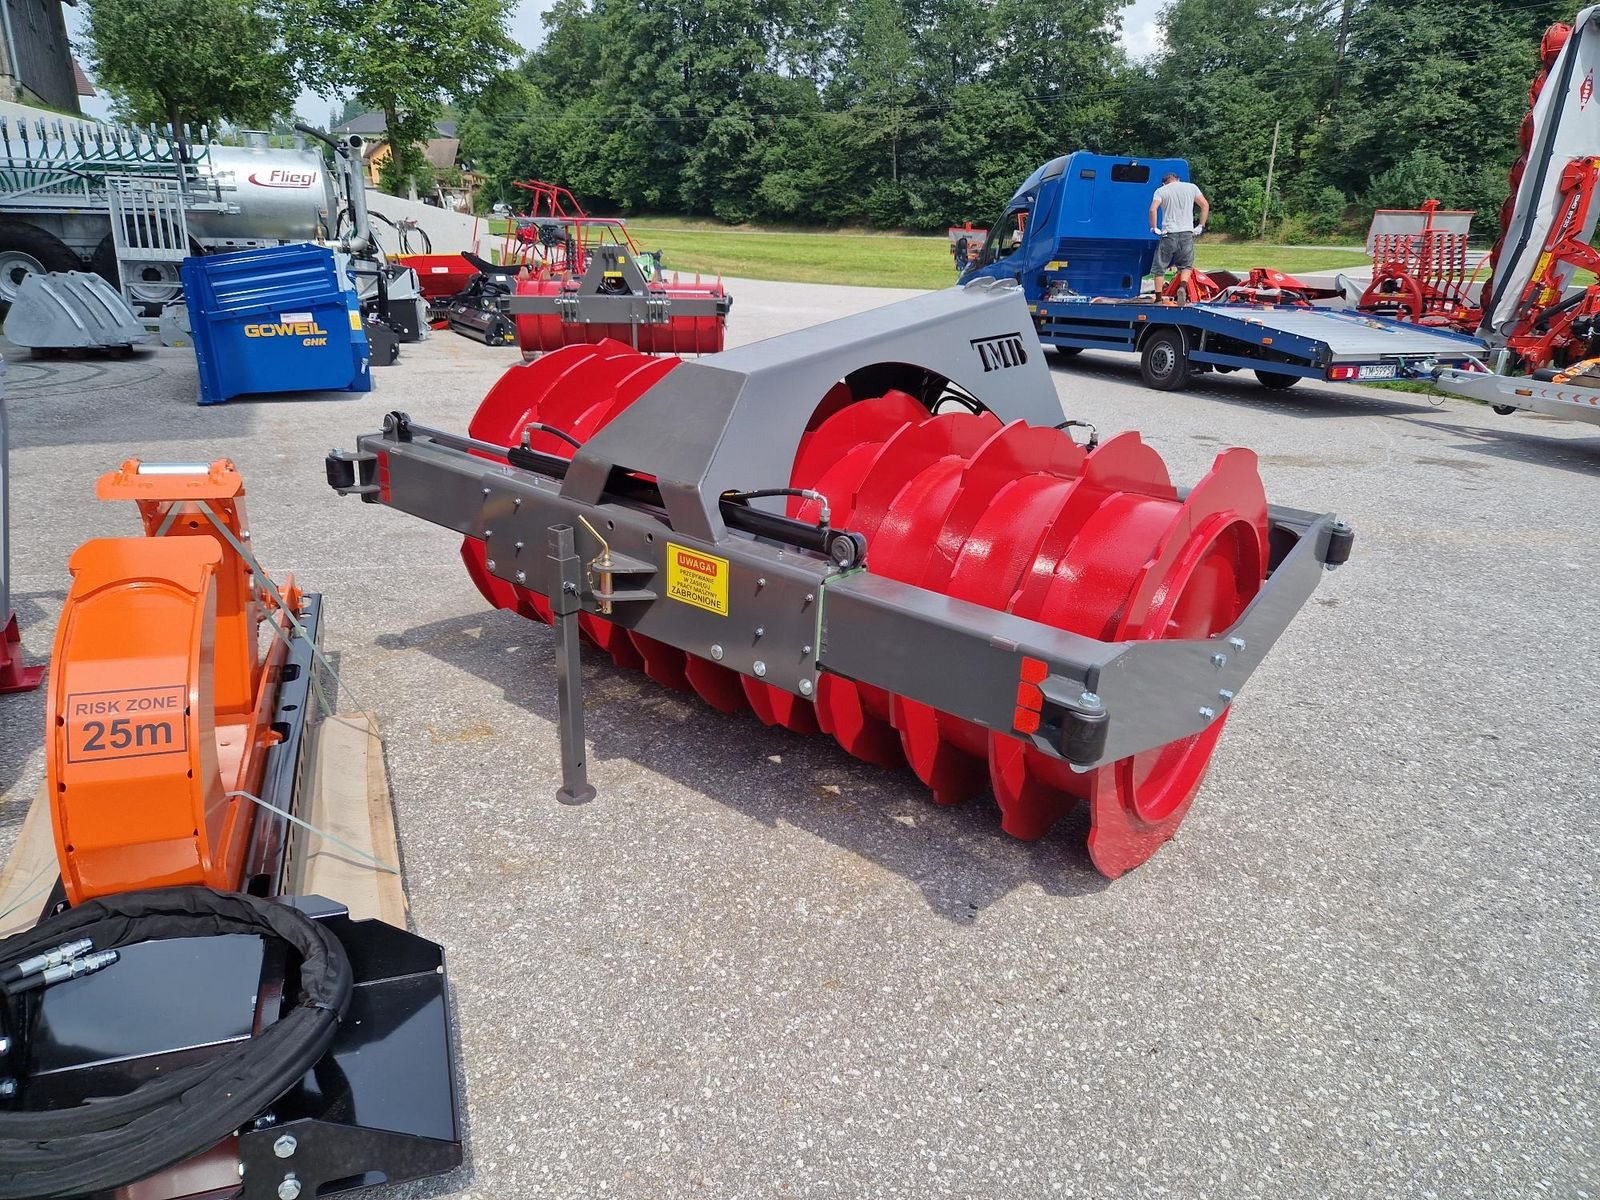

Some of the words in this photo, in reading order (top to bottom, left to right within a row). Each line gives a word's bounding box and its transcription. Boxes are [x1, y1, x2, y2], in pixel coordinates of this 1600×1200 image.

[269, 170, 317, 186] Fliegl
[302, 337, 328, 347] GNK
[969, 331, 1028, 372] TMB
[679, 554, 716, 574] UWAGA!
[679, 569, 715, 585] PRZEBYWANIE
[671, 586, 722, 609] ZABRONIONE
[676, 581, 693, 591] PRACY
[693, 586, 718, 599] MASZYNY
[75, 700, 120, 716] RISK
[126, 695, 178, 712] ZONE
[82, 718, 172, 752] 25m
